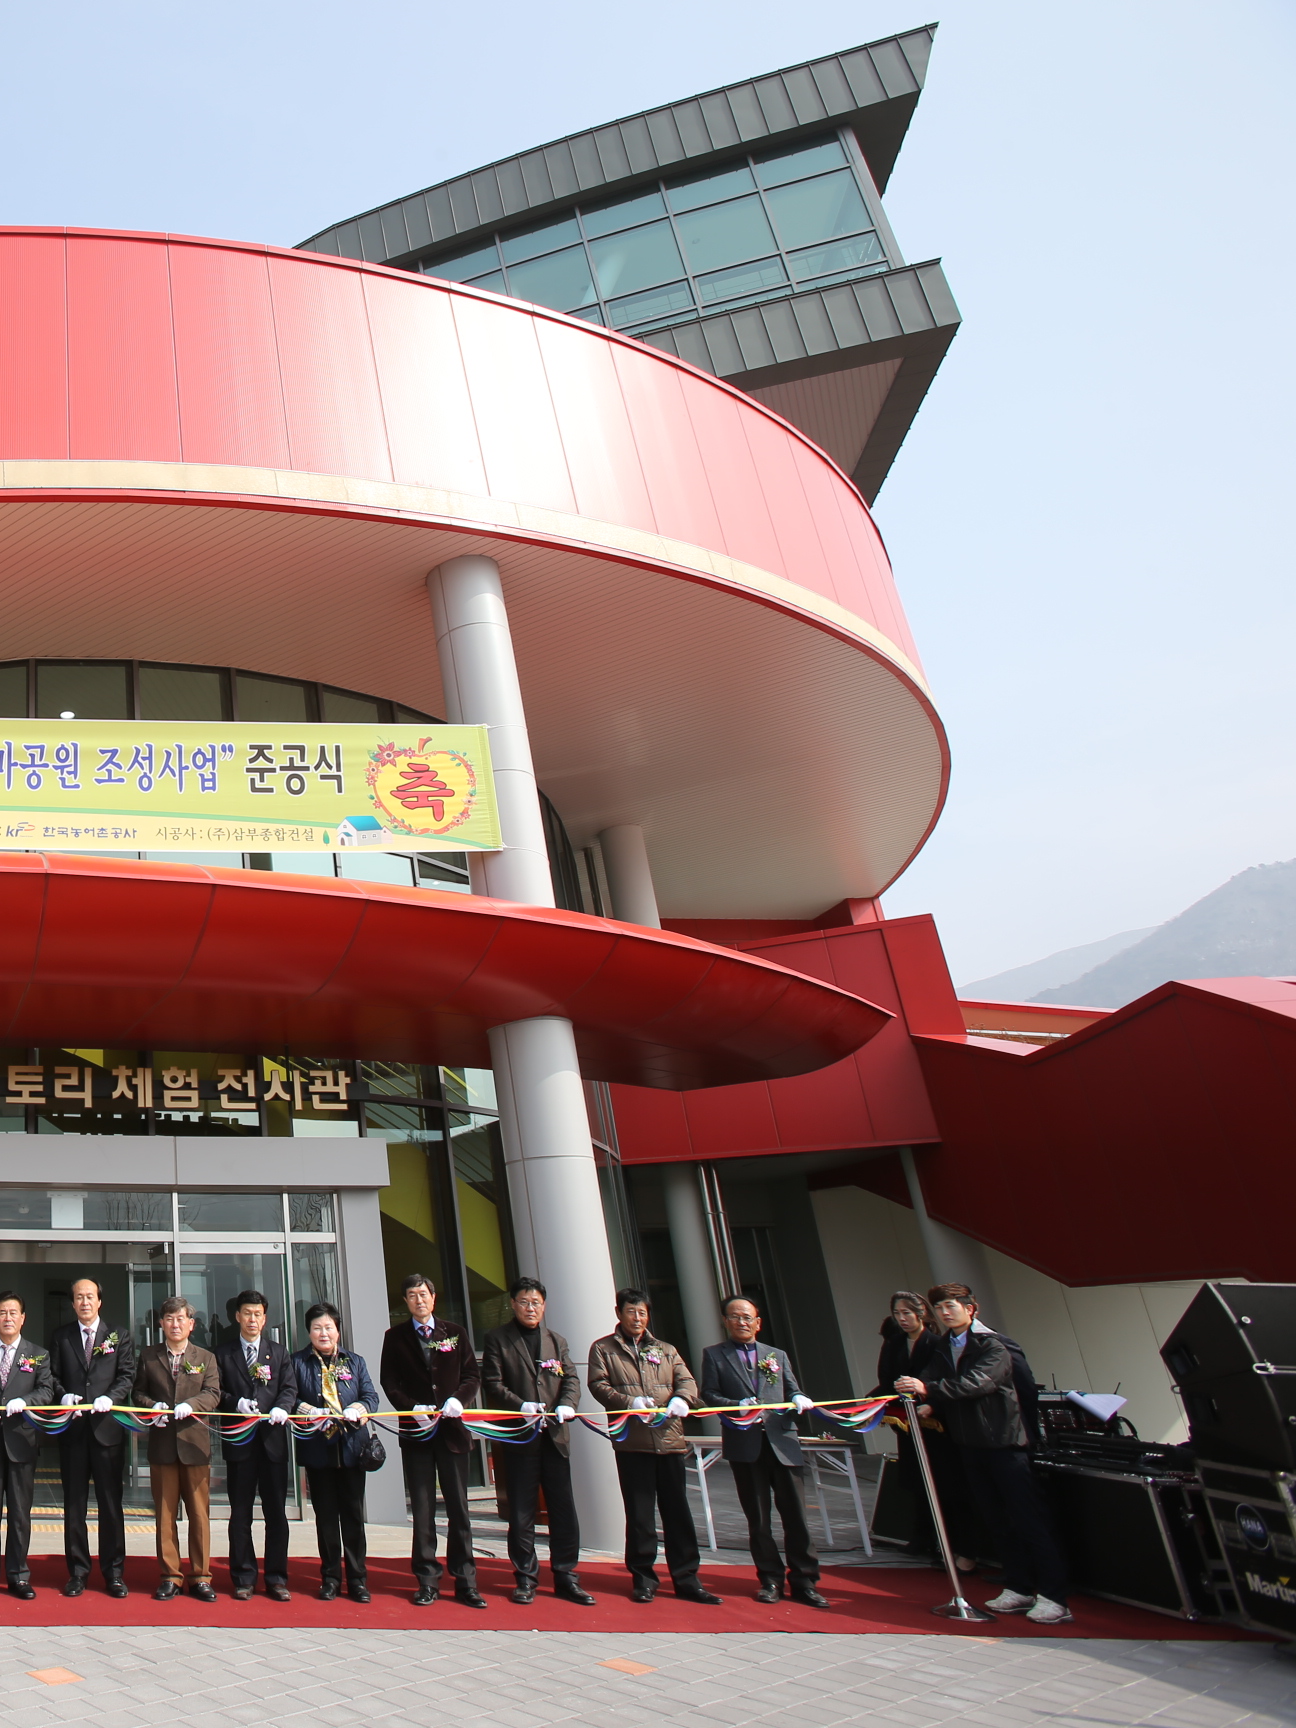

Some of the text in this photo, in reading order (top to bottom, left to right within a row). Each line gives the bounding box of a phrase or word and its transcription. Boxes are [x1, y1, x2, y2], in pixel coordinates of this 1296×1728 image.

[244, 743, 345, 795] 준공식
[390, 762, 456, 821] 축
[43, 826, 137, 839] 한국농어촌공사
[207, 827, 314, 843] (주)삼부종합건설
[111, 1064, 199, 1111] 체험
[217, 1067, 351, 1112] 전시관
